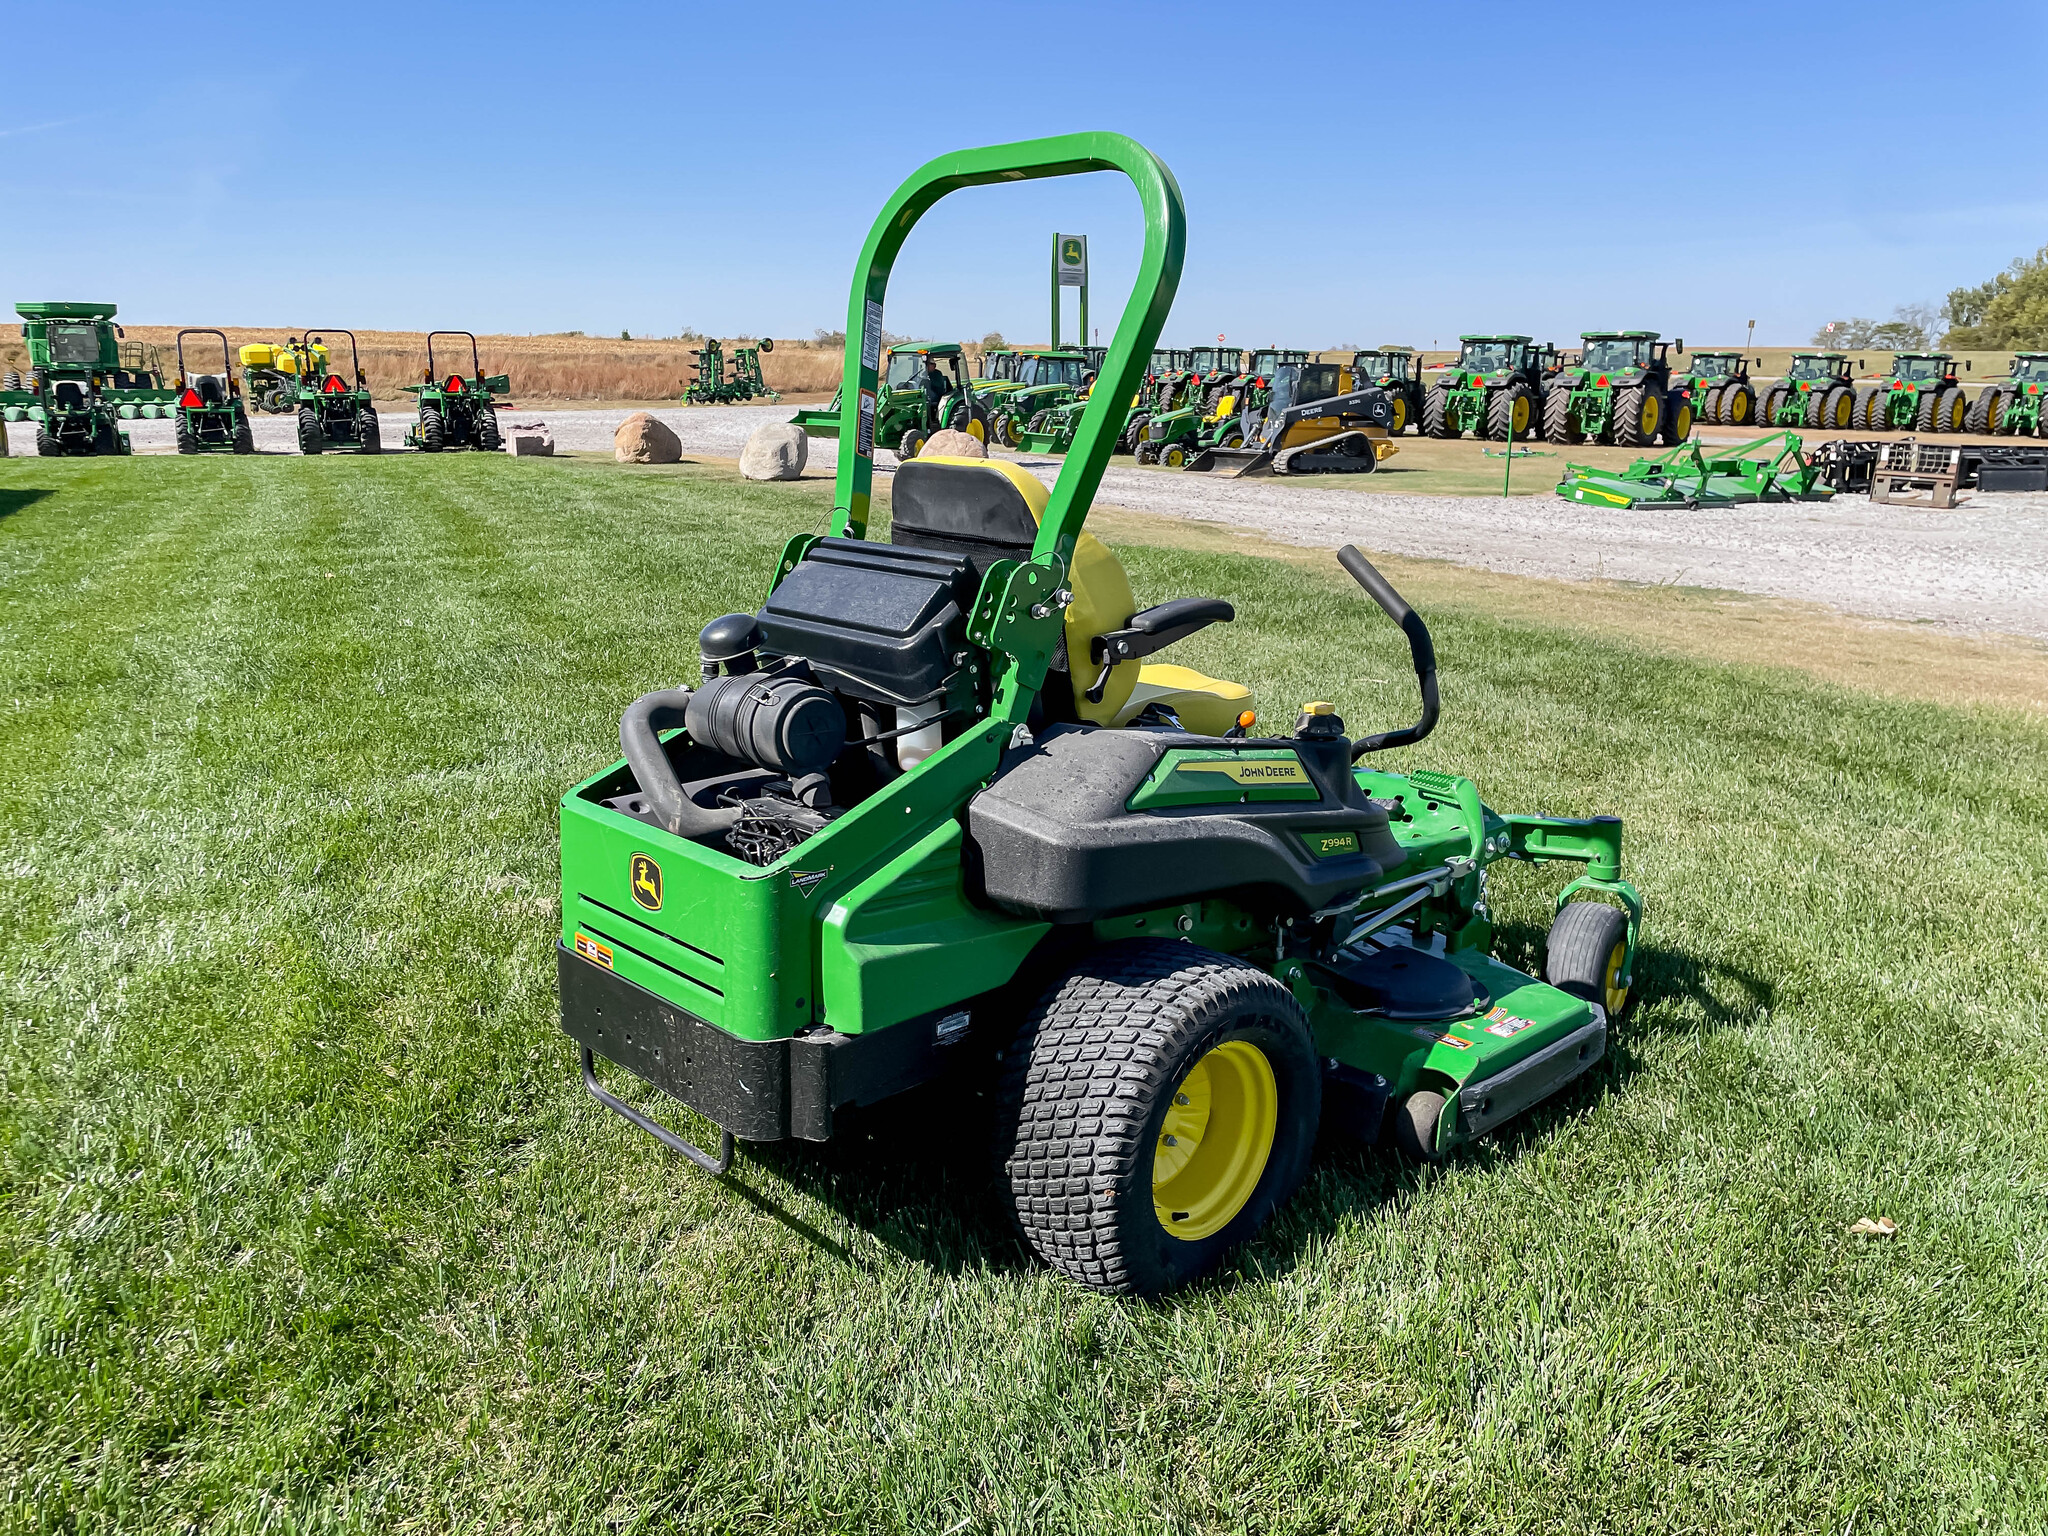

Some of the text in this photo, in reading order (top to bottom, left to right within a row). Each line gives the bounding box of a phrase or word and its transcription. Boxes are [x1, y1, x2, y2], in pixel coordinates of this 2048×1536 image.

[1301, 406, 1323, 416] DEERE
[1240, 766, 1296, 777] JOHN DEERE
[791, 872, 826, 885] LANDMARK
